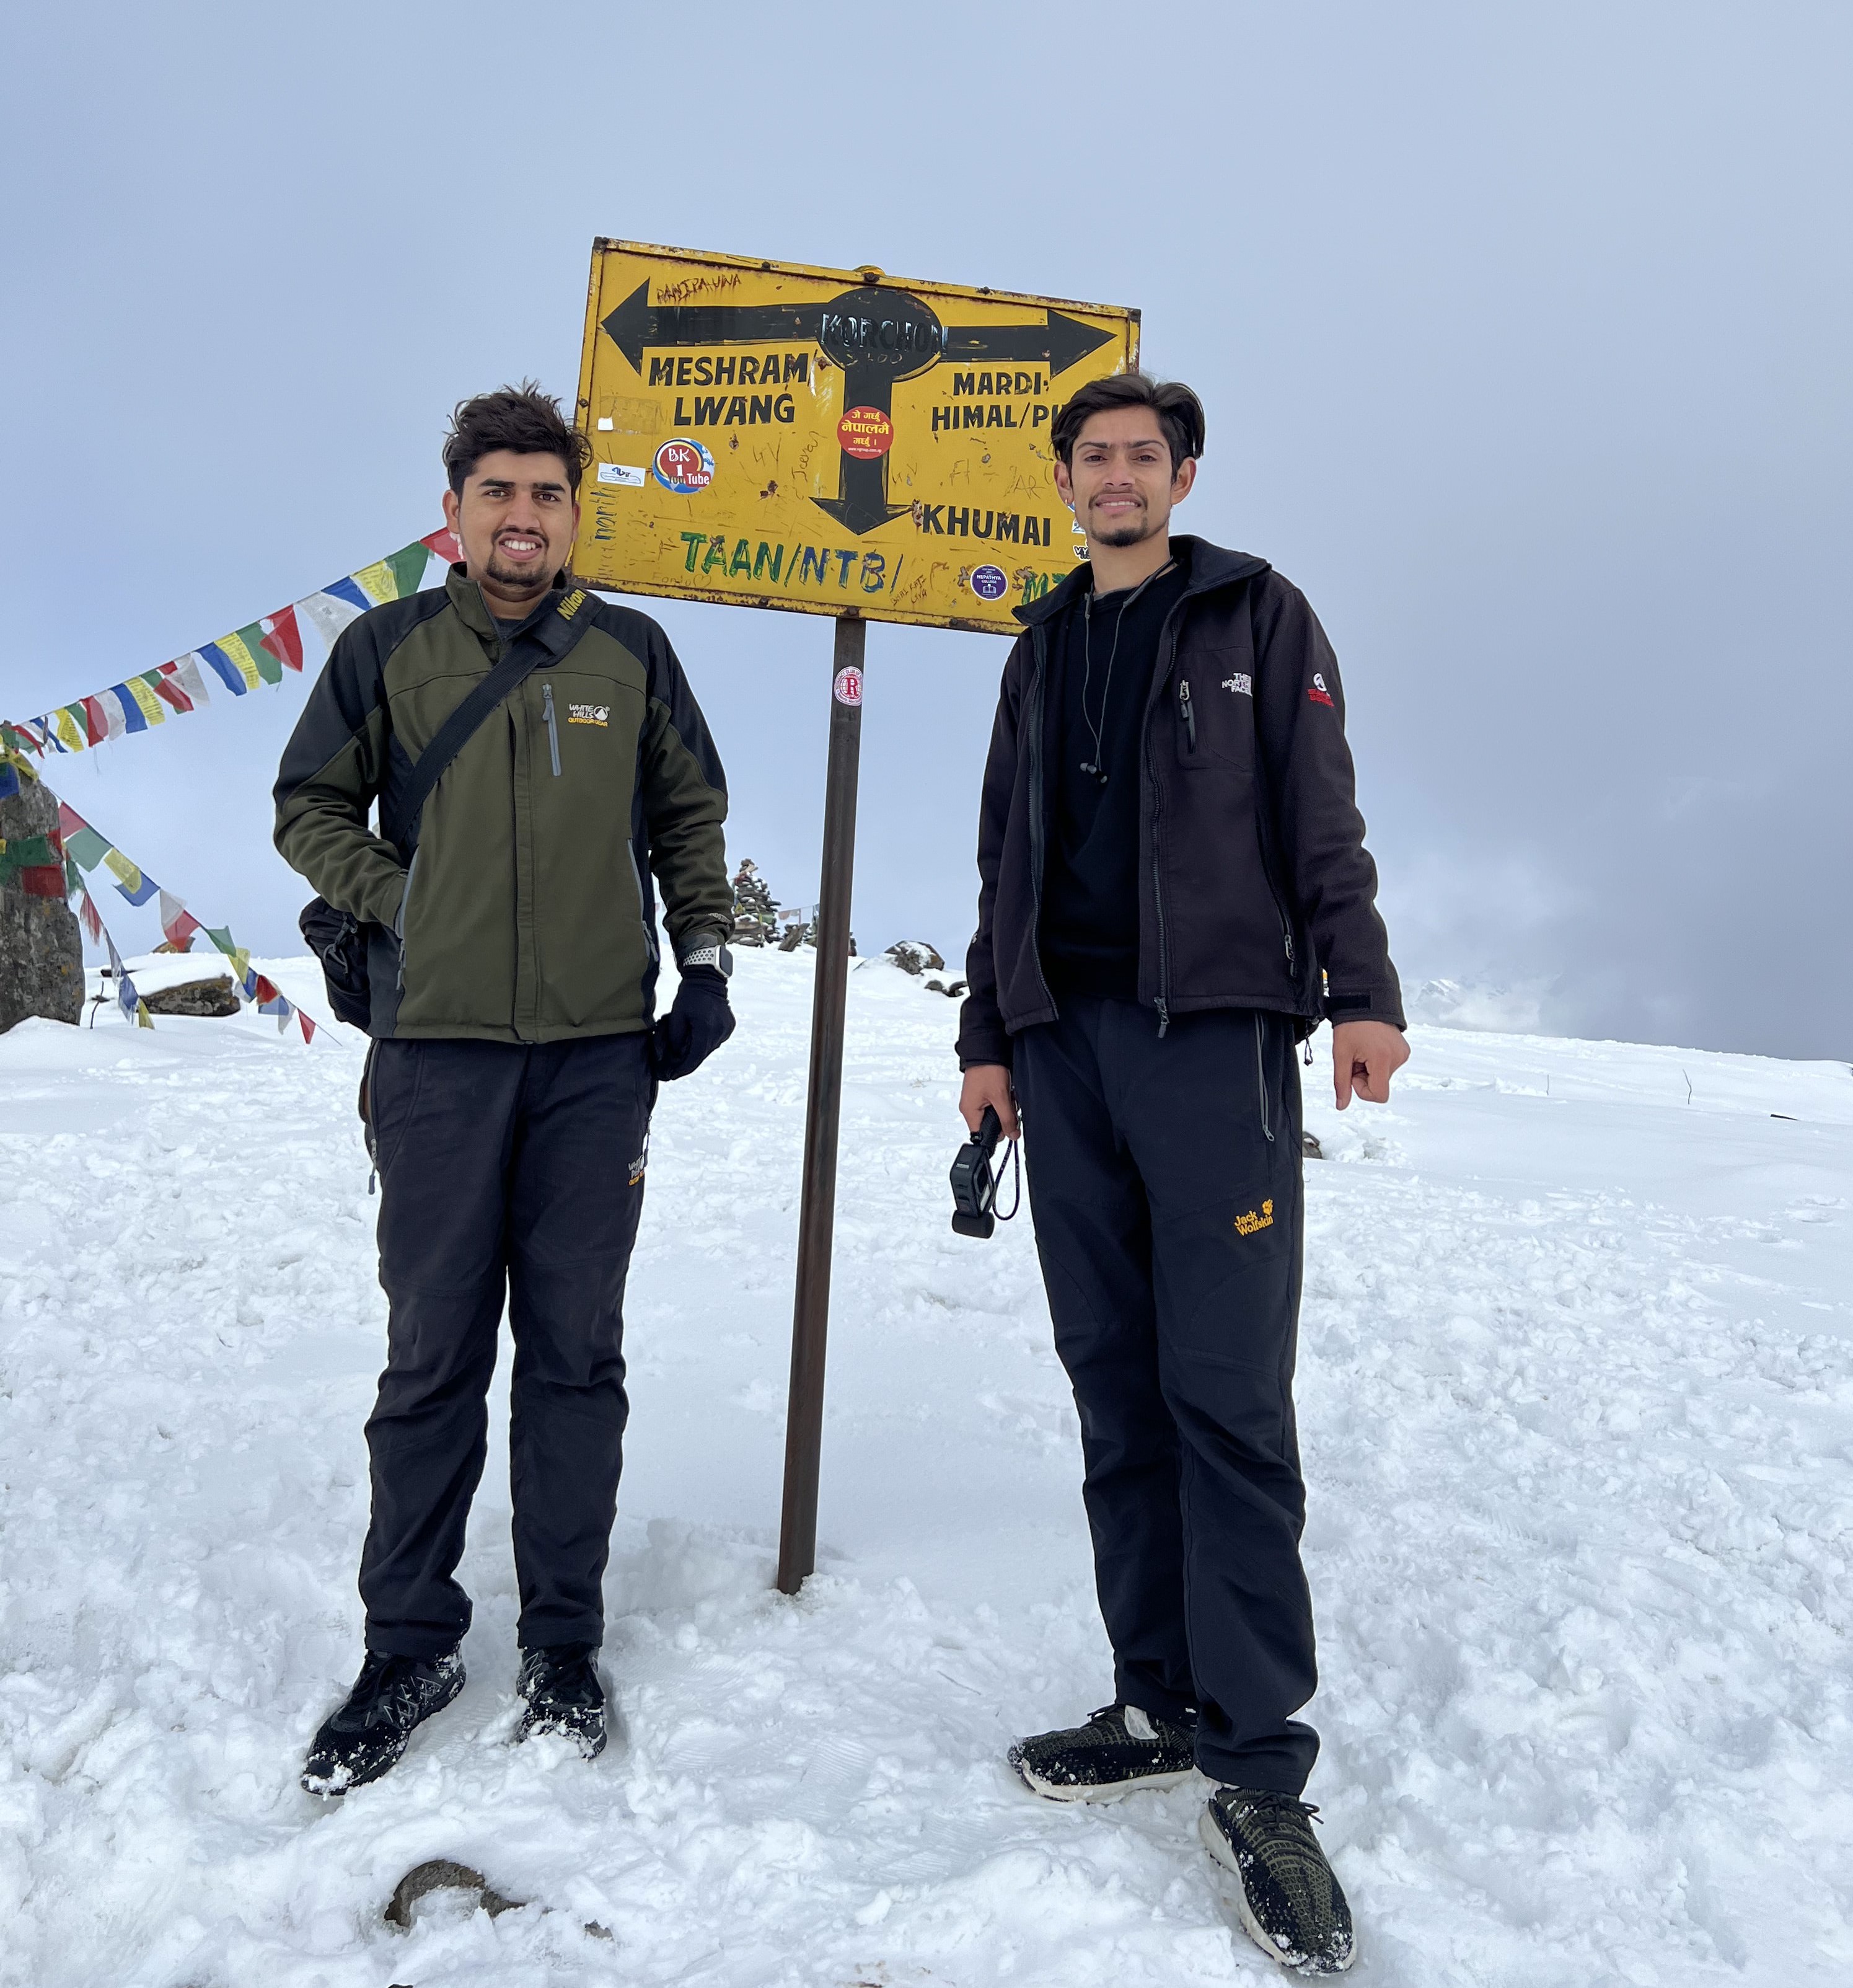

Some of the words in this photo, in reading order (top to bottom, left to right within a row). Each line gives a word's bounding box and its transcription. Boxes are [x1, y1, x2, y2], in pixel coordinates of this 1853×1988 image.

[674, 392, 795, 426] LWANG
[852, 410, 860, 418] जे
[668, 448, 691, 462] BK
[922, 503, 1051, 547] KHUMAI
[557, 589, 587, 621] Nikon
[845, 677, 859, 696] R
[1234, 1210, 1258, 1226] Jack
[1236, 1216, 1274, 1236] Wolfskin
